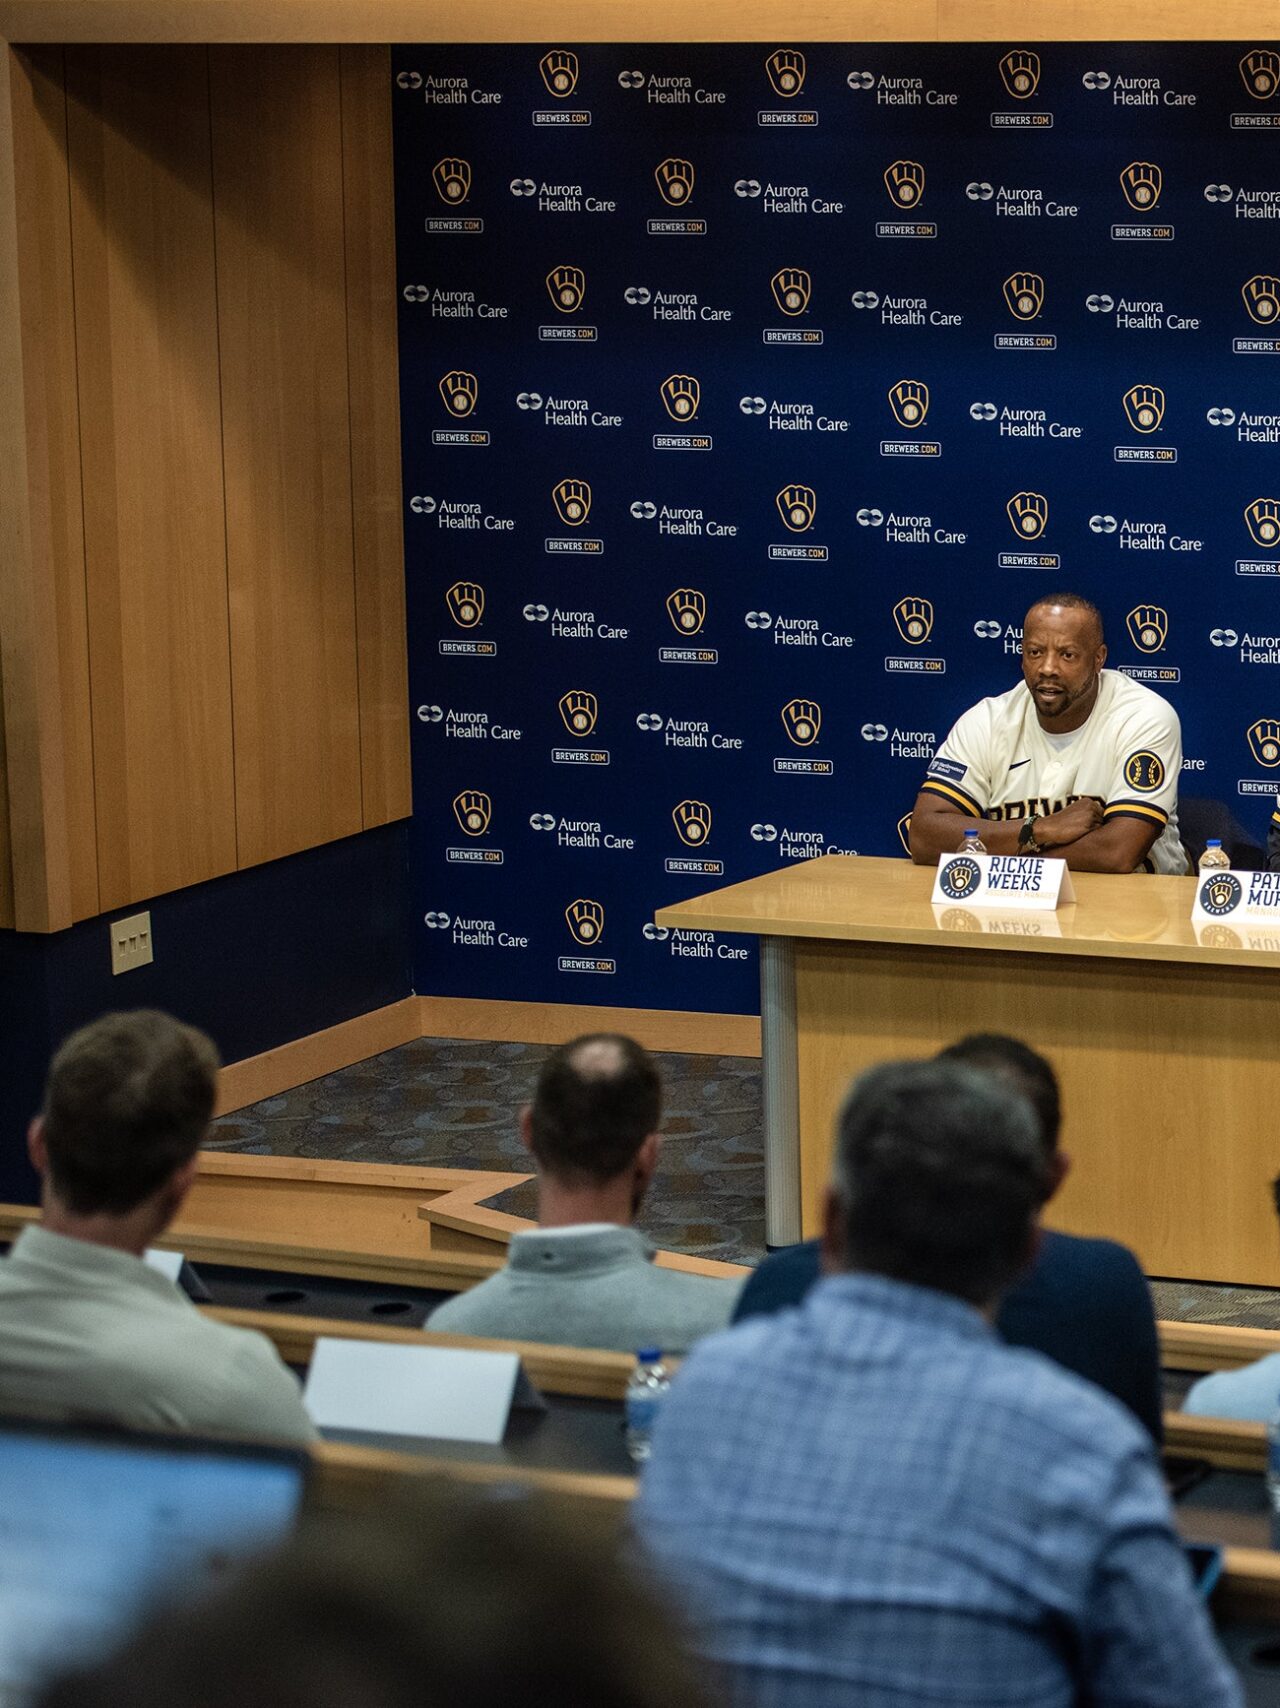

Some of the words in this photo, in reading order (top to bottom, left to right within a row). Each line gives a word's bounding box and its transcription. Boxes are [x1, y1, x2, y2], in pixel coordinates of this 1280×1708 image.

[423, 72, 468, 87] Aurora
[877, 74, 923, 89] Aurora
[424, 87, 466, 103] Health
[469, 88, 501, 103] Care
[877, 89, 922, 105] Health
[925, 90, 958, 105] Care
[535, 113, 587, 123] BREWERS.COM
[762, 114, 815, 124] BREWERS.COM
[764, 183, 809, 198] Aurora
[764, 198, 808, 214] Health
[811, 199, 844, 215] Care
[651, 222, 703, 232] BREWERS.COM
[1115, 228, 1170, 238] BREWERS.COM
[653, 290, 698, 305] Aurora
[1116, 298, 1164, 313] Aurora
[653, 305, 697, 321] Health
[700, 306, 732, 322] Care
[1116, 313, 1162, 330] Health
[1166, 314, 1199, 330] Care
[767, 333, 820, 343] BREWERS.COM
[544, 395, 589, 411] Aurora
[544, 410, 587, 426] Health
[590, 412, 622, 427] Care
[1000, 406, 1047, 421] Aurora
[435, 432, 486, 442] BREWERS.COM
[1000, 421, 1045, 437] Health
[1049, 422, 1082, 439] Care
[884, 444, 938, 454] BREWERS.COM
[438, 498, 481, 514] Aurora
[438, 513, 480, 529] Health
[483, 515, 514, 530] Care
[886, 512, 932, 527] Aurora
[886, 526, 931, 543] Health
[934, 528, 966, 545] Care
[548, 541, 600, 552] BREWERS.COM
[1002, 556, 1057, 567] BREWERS.COM
[551, 607, 595, 623] Aurora
[551, 622, 594, 638] Health
[597, 624, 628, 640] Care
[662, 651, 714, 662] BREWERS.COM
[665, 717, 709, 733] Aurora
[665, 731, 708, 749] Health
[711, 734, 742, 750] Care
[777, 762, 830, 773] BREWERS.COM
[1182, 757, 1205, 771] are
[557, 817, 601, 833] Aurora
[557, 831, 600, 848] Health
[603, 834, 634, 850] Care
[668, 861, 720, 873] BREWERS.COM
[989, 857, 1045, 875] RICKIE
[987, 873, 1042, 892] WEEKS
[452, 915, 495, 931] Aurora
[452, 929, 494, 946] Health
[497, 932, 527, 948] Care
[671, 928, 715, 943] Aurora
[670, 941, 714, 959] Health
[717, 944, 748, 961] Care
[561, 959, 612, 971] BREWERS.COM
